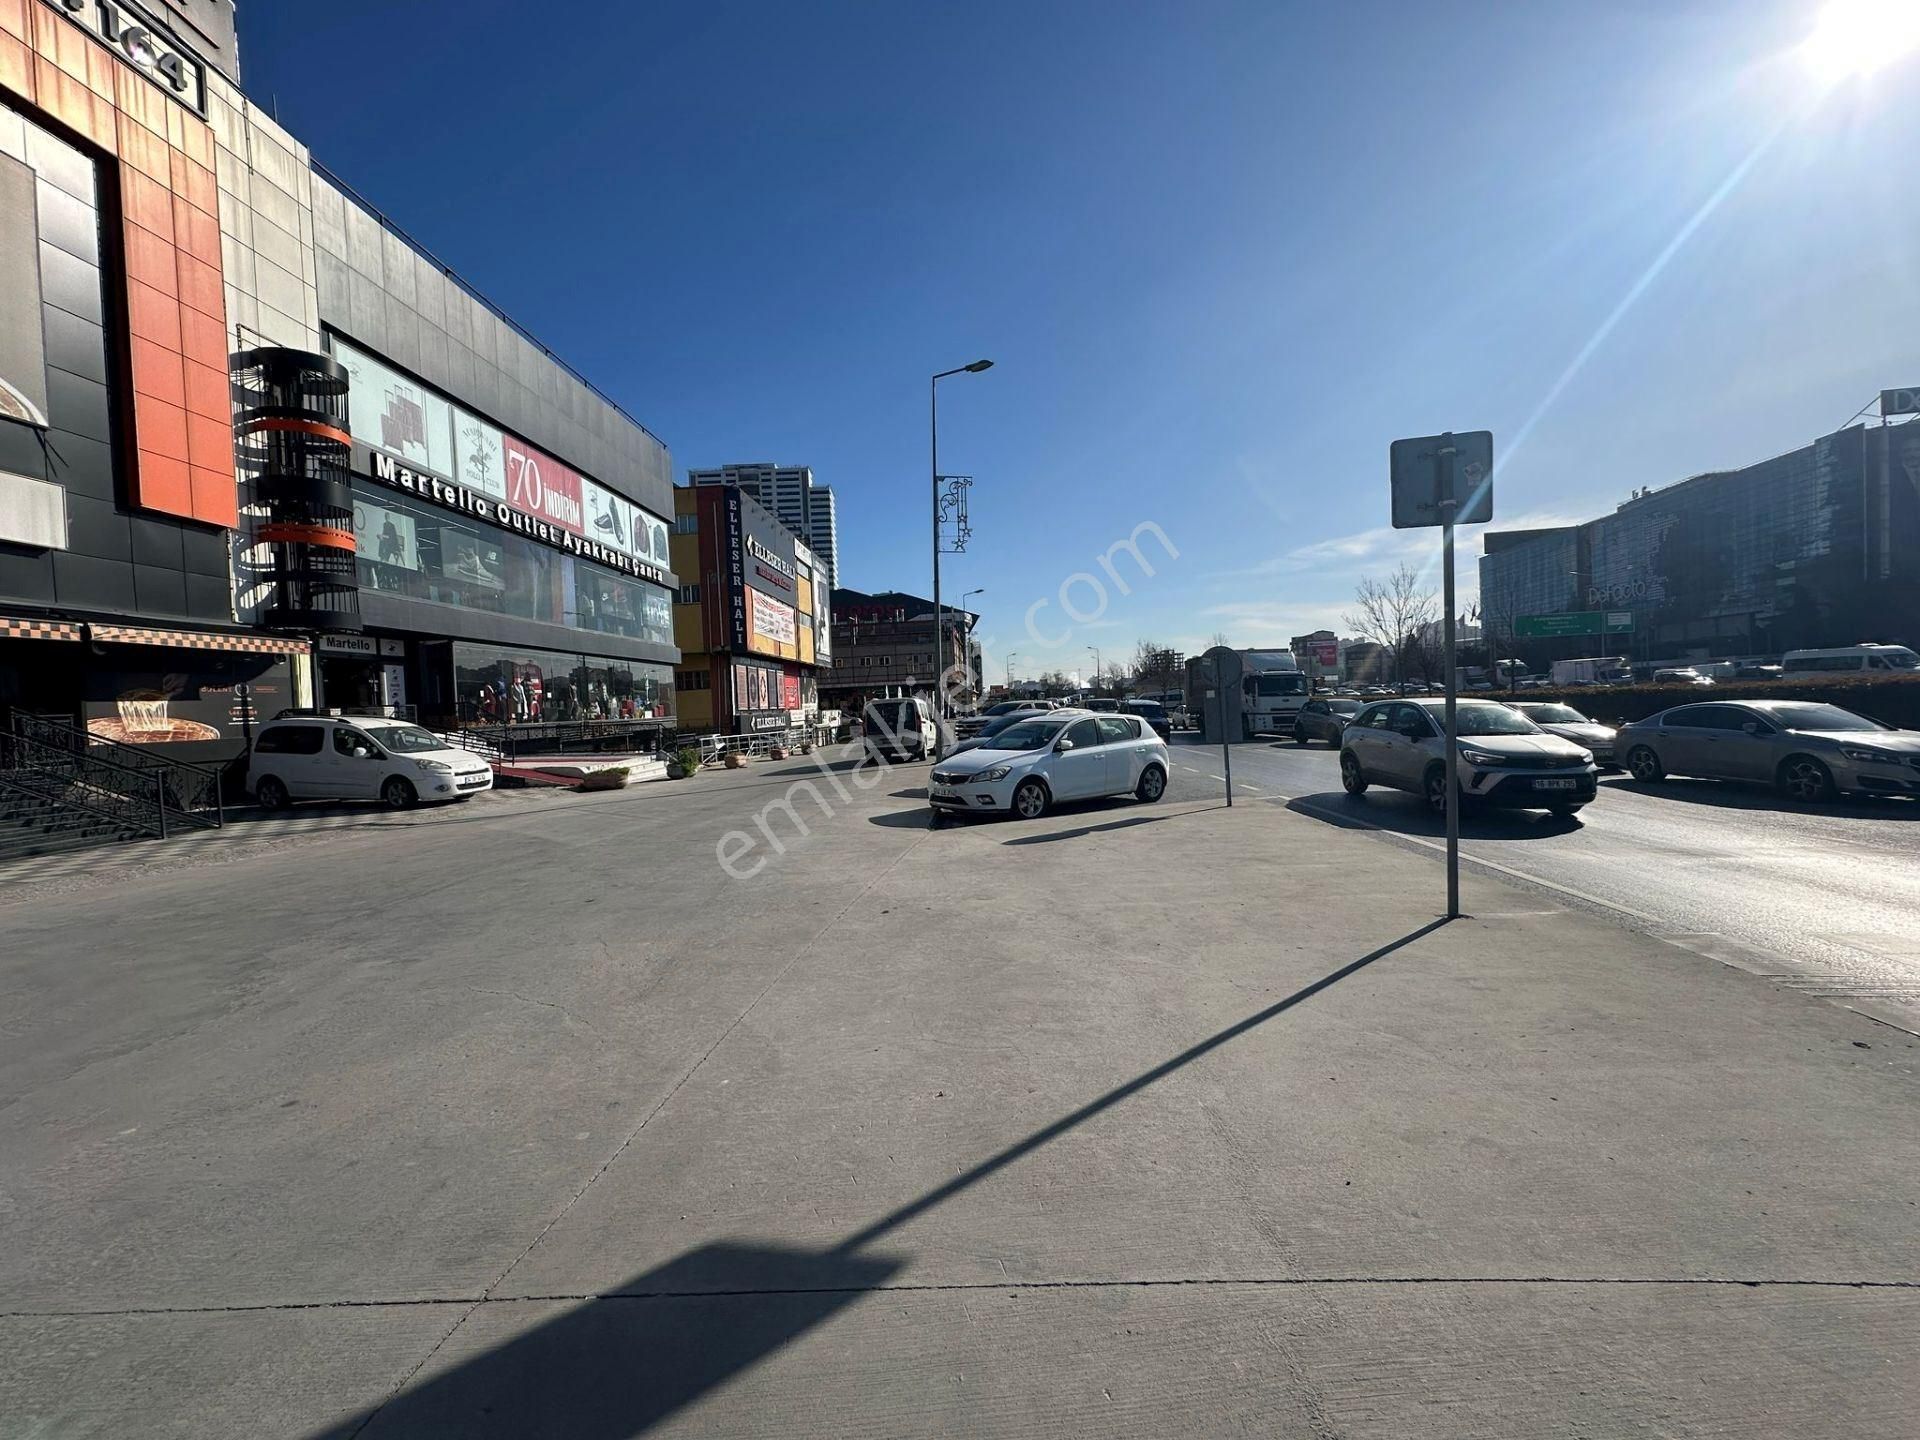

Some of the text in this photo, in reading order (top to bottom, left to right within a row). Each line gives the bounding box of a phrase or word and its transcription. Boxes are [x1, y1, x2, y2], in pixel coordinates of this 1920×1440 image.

[376, 452, 663, 582] Martello Outlet Ayakkabı Çanta
[508, 448, 542, 510] 70
[729, 499, 744, 645] ELLESER HALI
[326, 636, 370, 651] Martello
